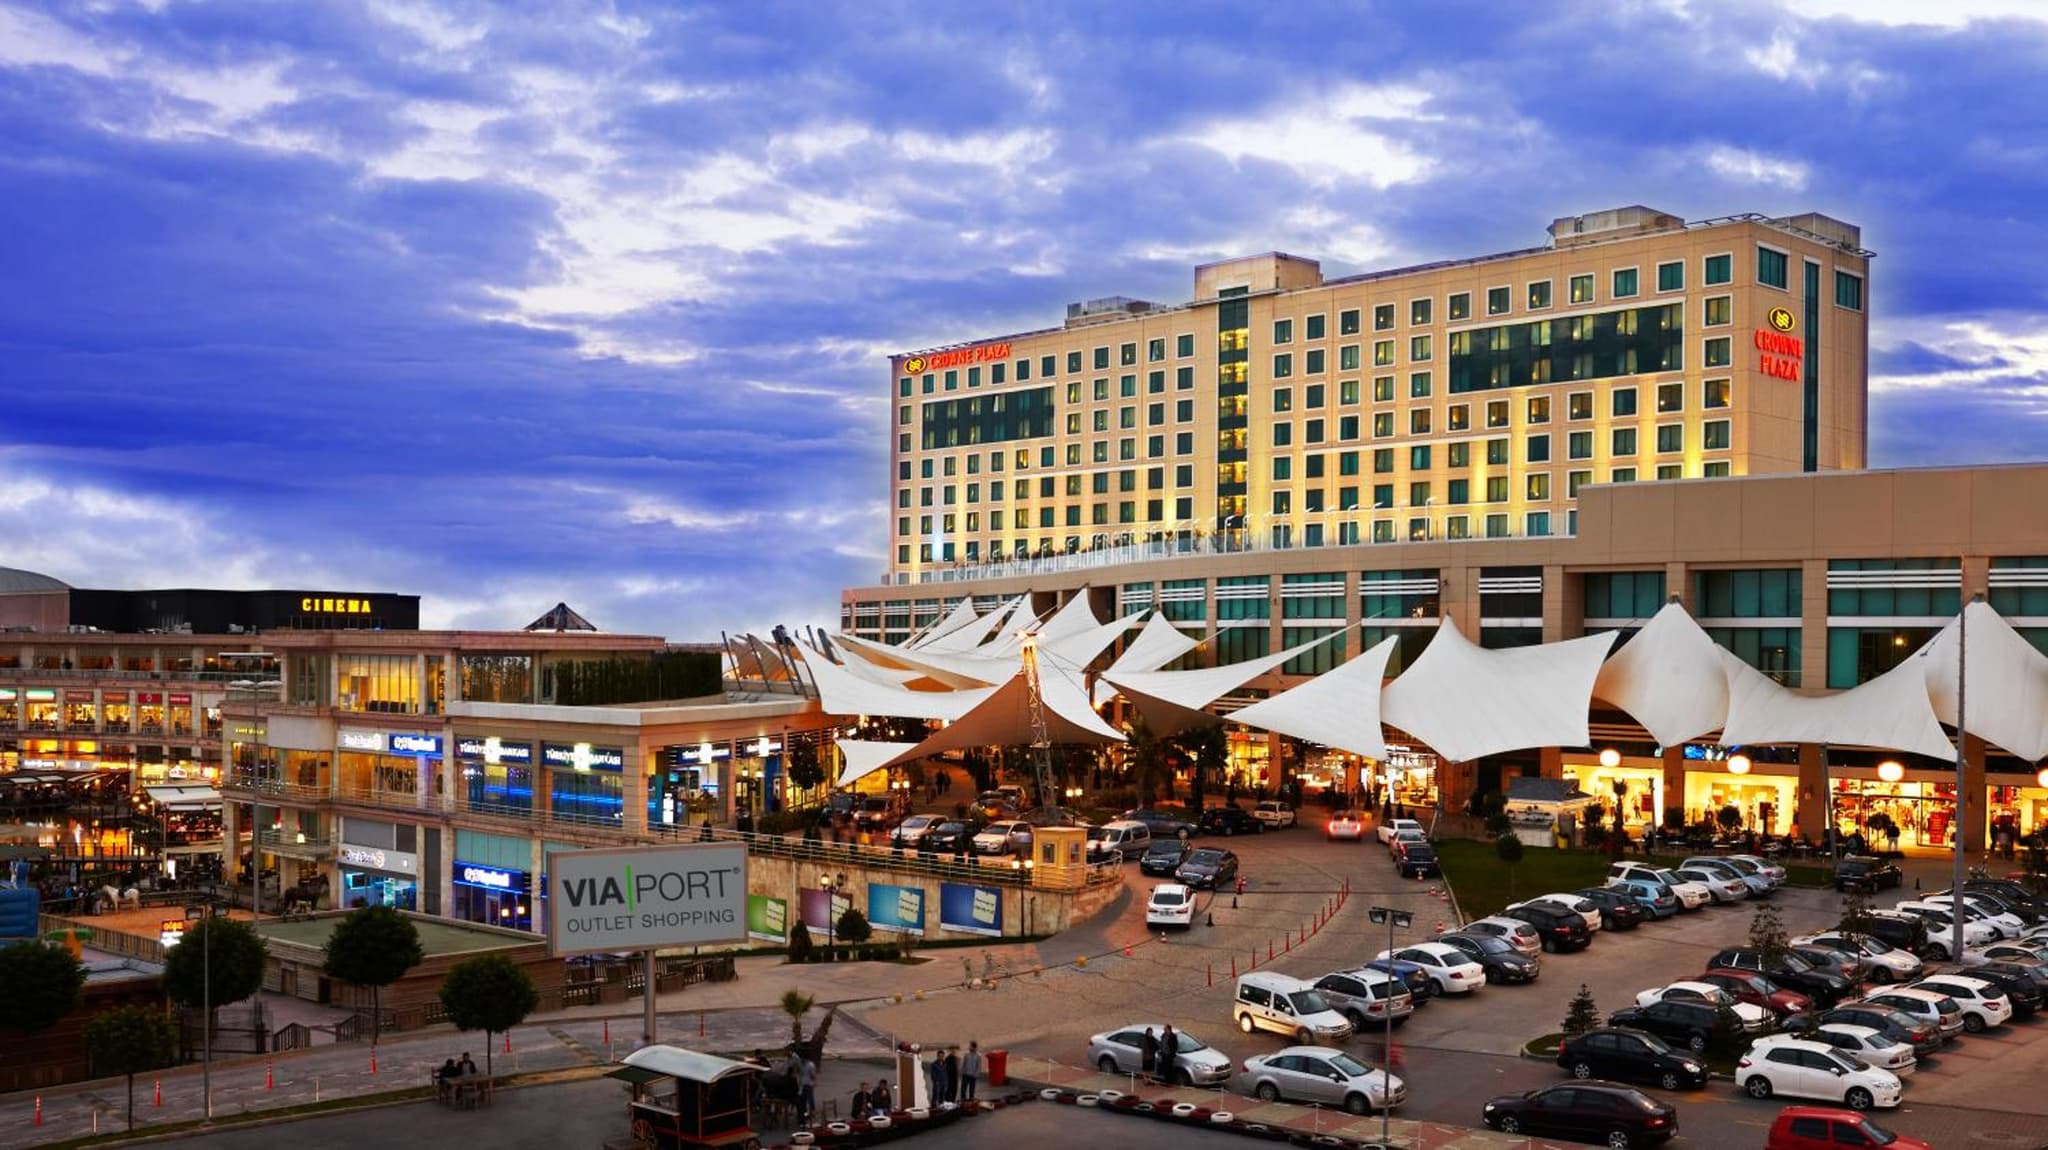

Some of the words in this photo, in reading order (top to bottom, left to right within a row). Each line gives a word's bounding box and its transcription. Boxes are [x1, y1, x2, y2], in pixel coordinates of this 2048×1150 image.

[930, 349, 974, 369] CROWNE
[975, 343, 1010, 360] PLAZA
[1755, 329, 1803, 360] CROWNE
[1760, 354, 1800, 382] PLAZA
[302, 598, 372, 613] CINEMA
[567, 915, 635, 933] OUTLET
[641, 908, 736, 928] SHOPPING
